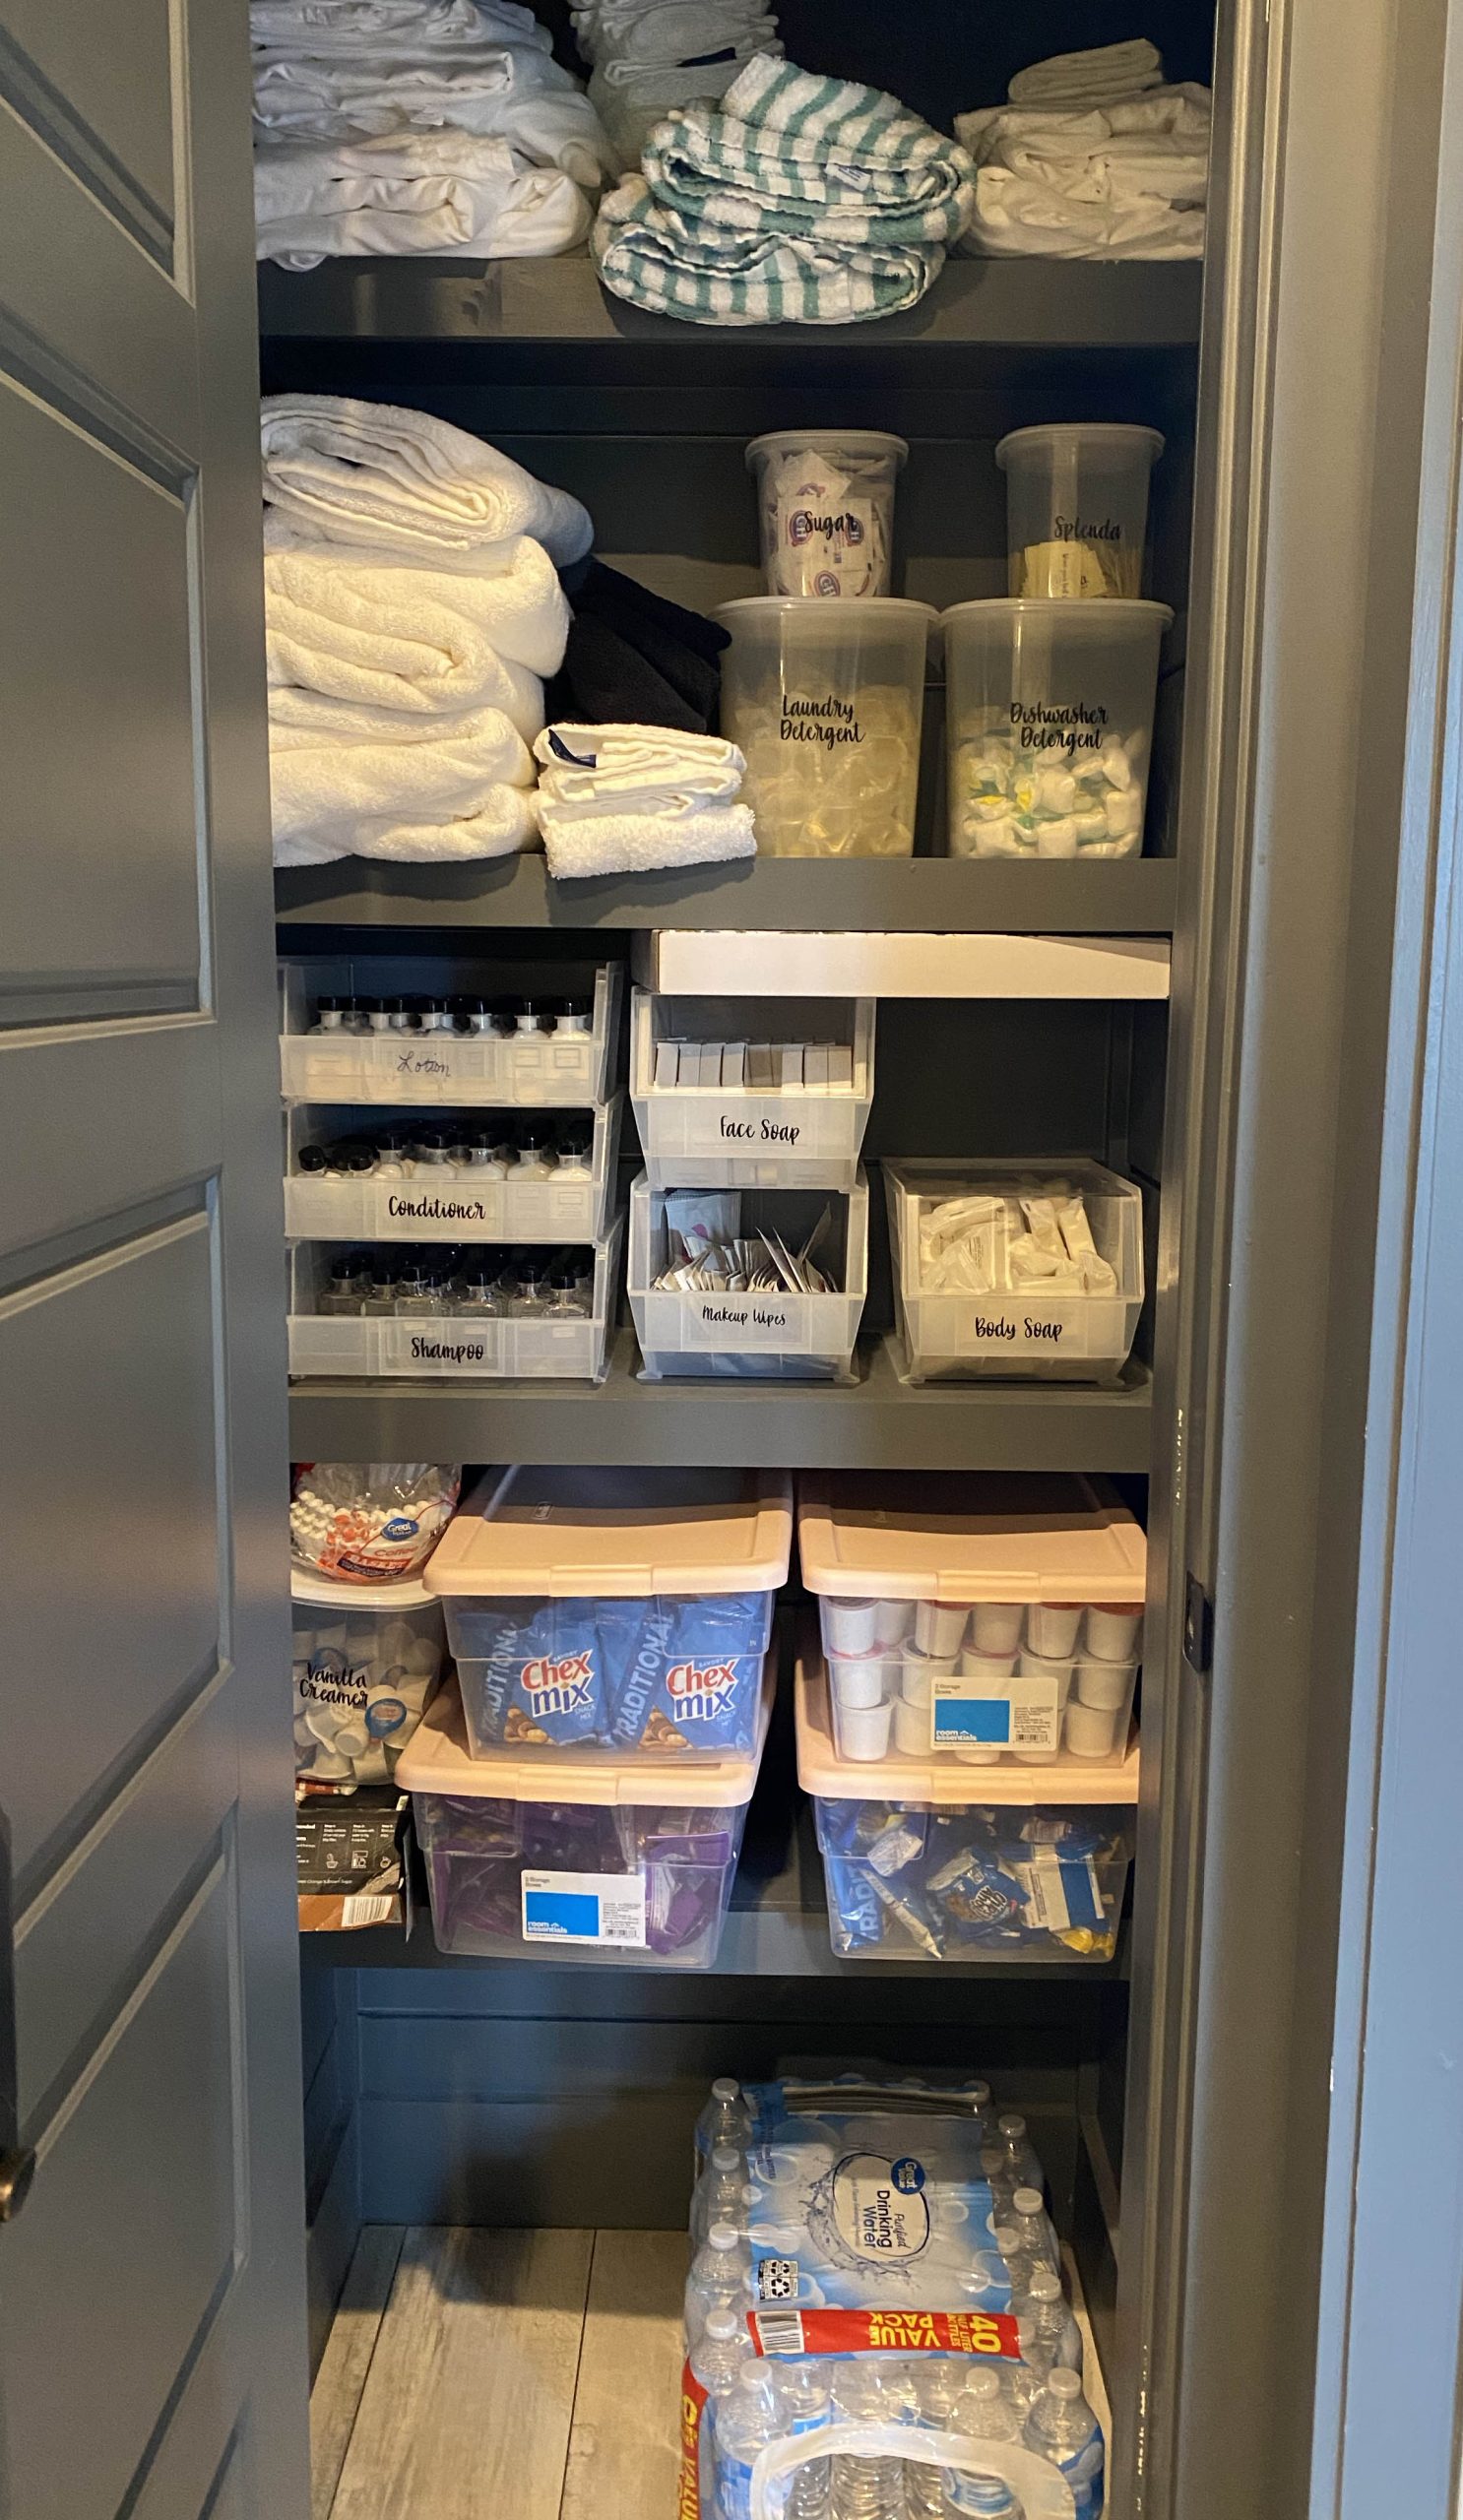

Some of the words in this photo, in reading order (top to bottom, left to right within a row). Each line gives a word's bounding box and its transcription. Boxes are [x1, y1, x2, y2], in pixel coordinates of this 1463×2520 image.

[803, 510, 858, 540] Sugar
[1054, 515, 1121, 542] Splenda
[783, 694, 854, 724] Laundry
[1010, 701, 1109, 724] Dishwasher
[780, 719, 866, 751] Detergent
[1021, 726, 1104, 756] Detergent
[397, 1050, 451, 1077] Lotion
[720, 1114, 755, 1138] Face
[760, 1118, 800, 1146] Soap
[388, 1195, 486, 1220] Conditioner
[702, 1304, 748, 1326] Makeup
[975, 1316, 1016, 1341] Body
[1024, 1317, 1063, 1343] Soap
[411, 1337, 484, 1364] Shampoo
[306, 1662, 367, 1688] Vanilla
[521, 1651, 593, 1691] Chex
[612, 1613, 675, 1741] TRADITIONAL
[667, 1659, 739, 1696] Chex
[299, 1678, 369, 1707] Creamer
[533, 1675, 593, 1716] mix
[675, 1682, 736, 1720] mix
[905, 2162, 918, 2189] Great
[862, 2206, 878, 2248] Water
[875, 2190, 893, 2248] Drinking
[894, 2213, 913, 2249] Purified
[869, 2312, 934, 2329] PACK
[969, 2314, 1002, 2353] 40
[867, 2324, 942, 2348] VALUE
[959, 2331, 974, 2354] LITER
[680, 2457, 699, 2520] VALU
